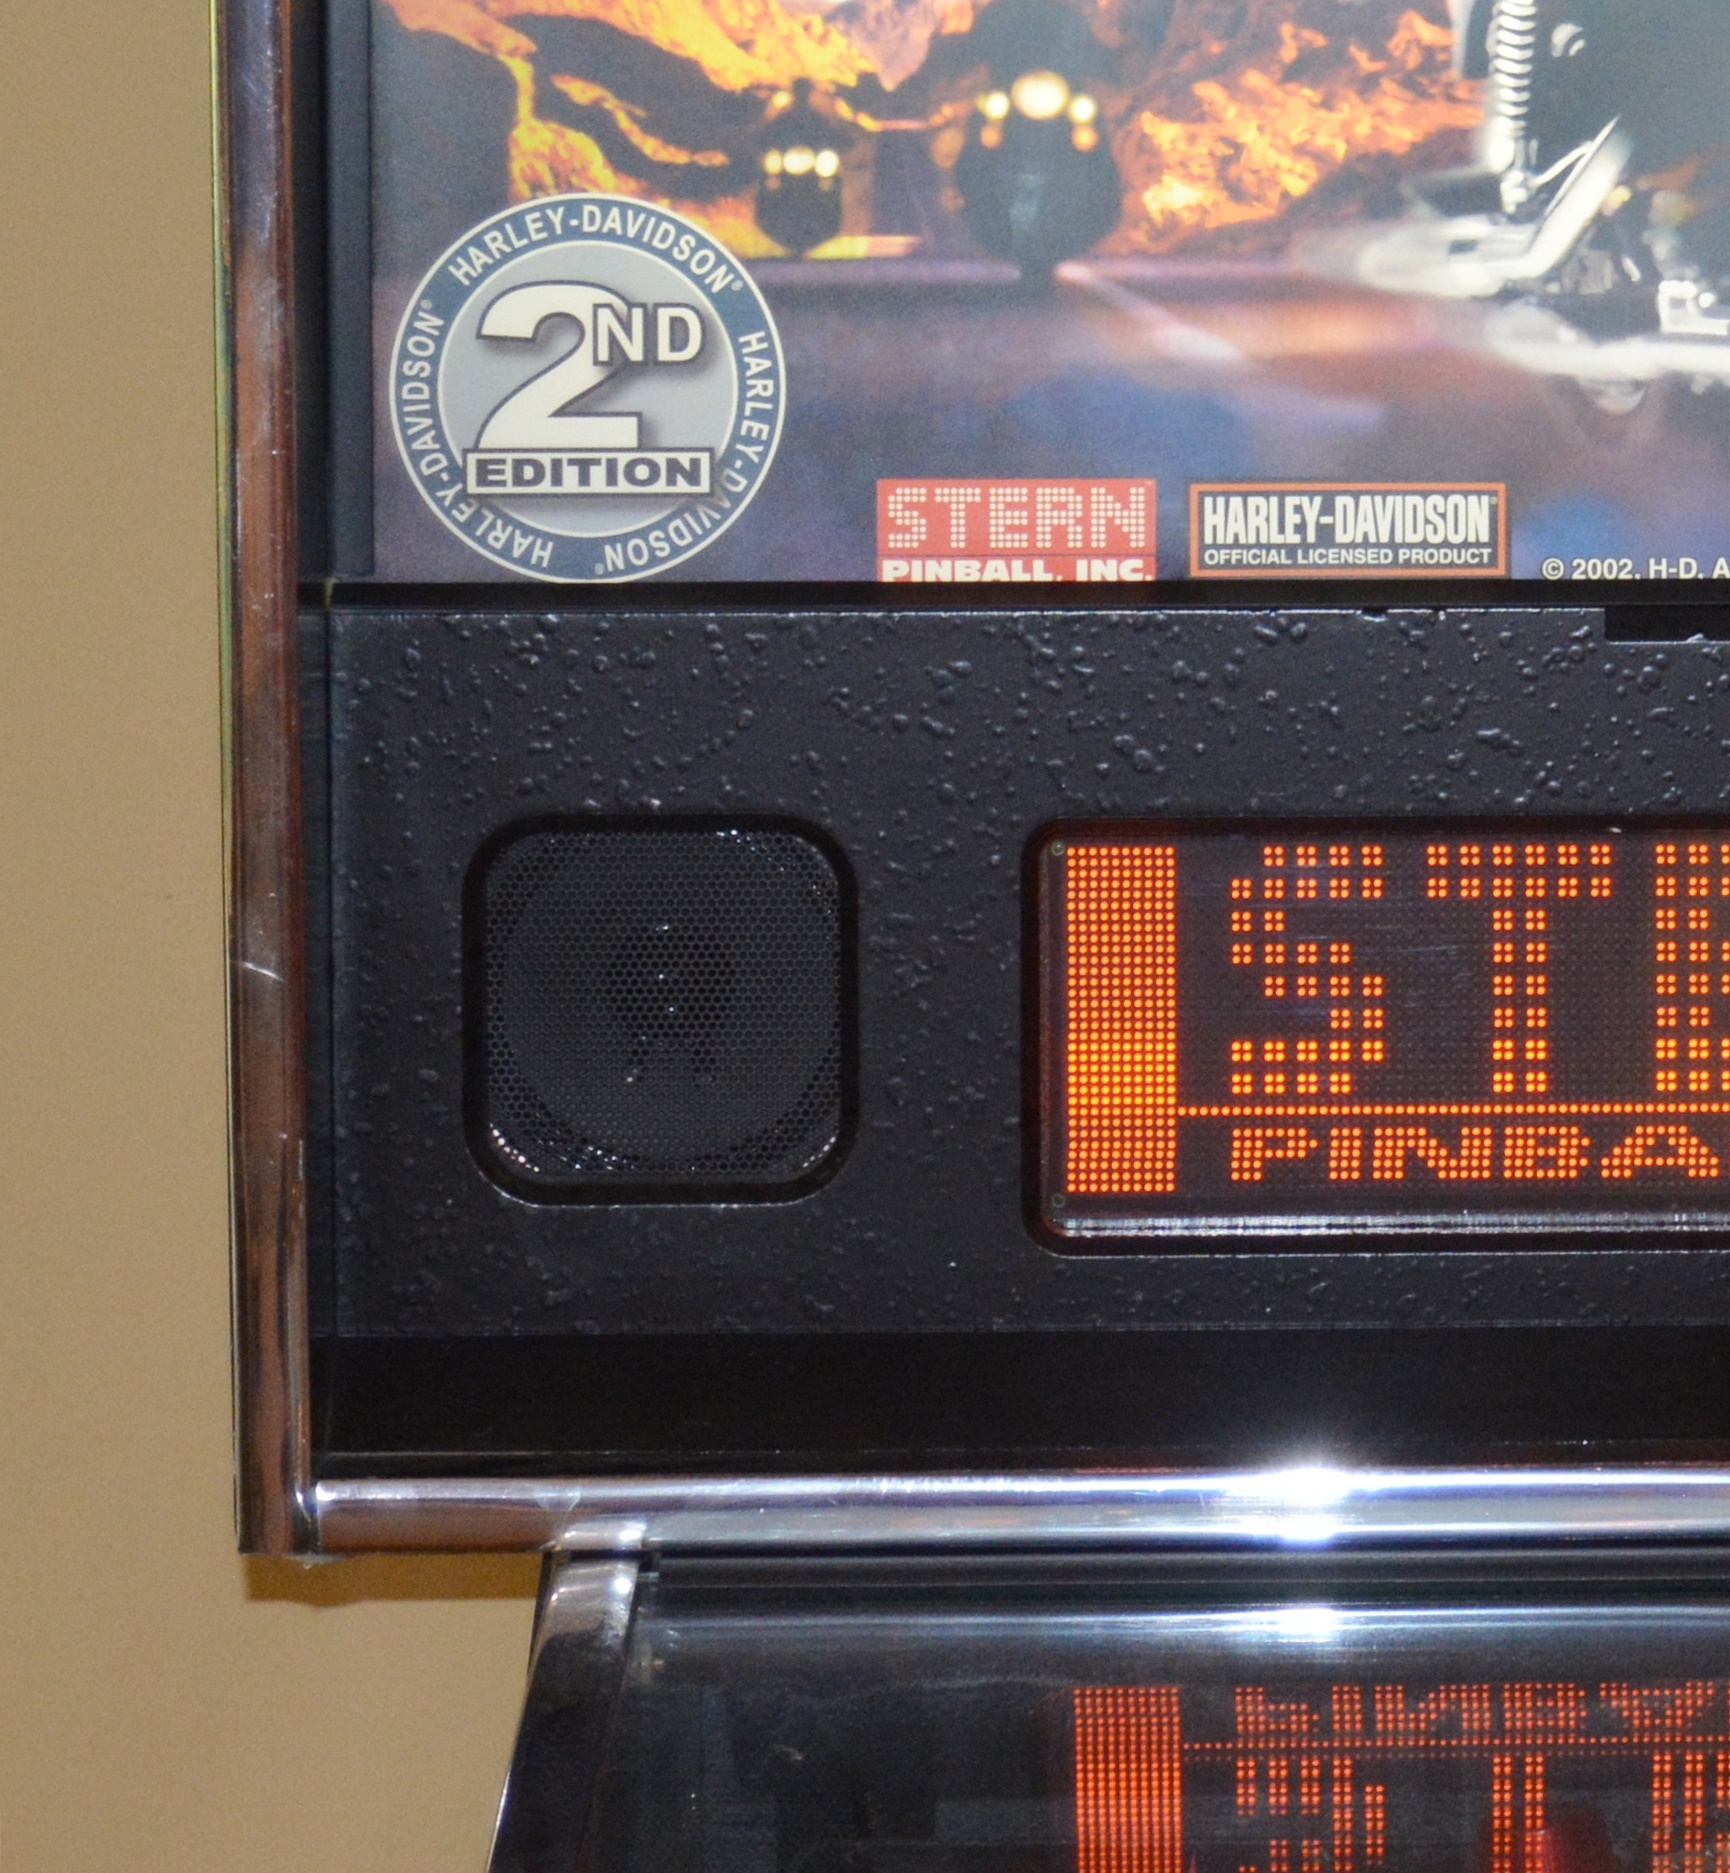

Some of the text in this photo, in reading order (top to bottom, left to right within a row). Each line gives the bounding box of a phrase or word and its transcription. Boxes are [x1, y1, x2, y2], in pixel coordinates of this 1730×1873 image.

[475, 457, 702, 488] EDITION
[887, 486, 1146, 549] STERN
[1204, 547, 1493, 565] OFFICIAL LICENSED PRODUCT
[1075, 559, 1154, 582] INC.
[1571, 558, 1641, 580] 2002.
[1648, 558, 1704, 580] H-D.
